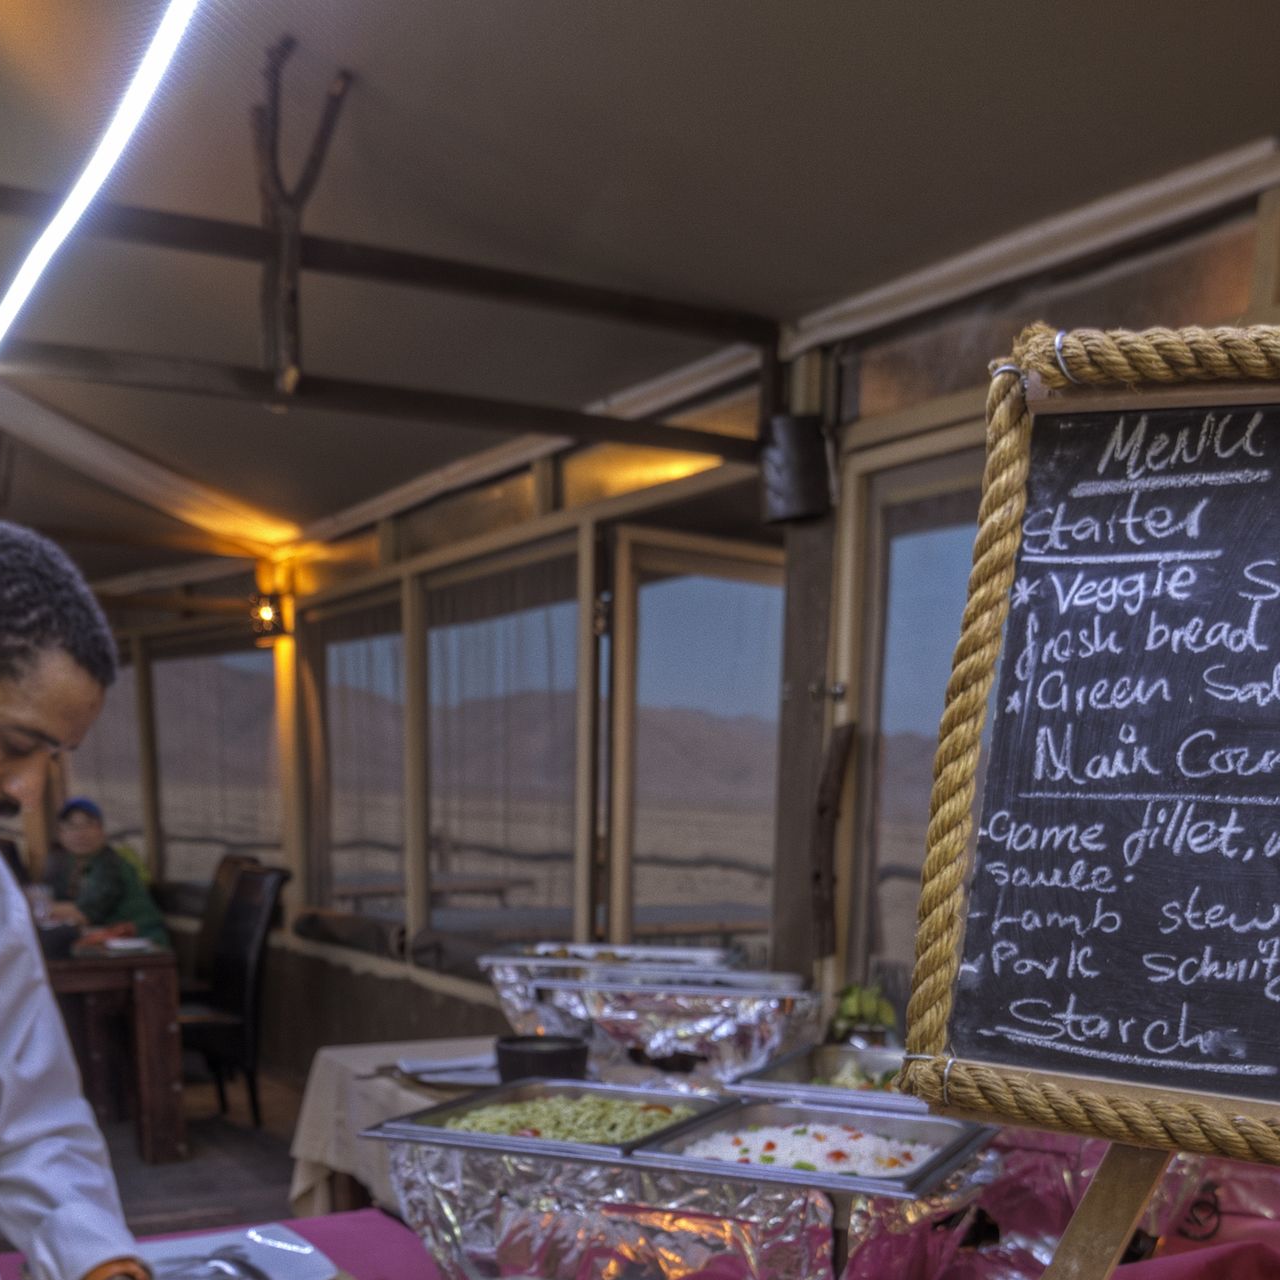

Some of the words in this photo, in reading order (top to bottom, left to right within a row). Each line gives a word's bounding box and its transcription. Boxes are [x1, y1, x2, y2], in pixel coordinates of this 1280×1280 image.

[1022, 490, 1209, 554] Starter
[1050, 560, 1197, 616] Veggie
[1145, 598, 1269, 654] bread
[1036, 670, 1171, 714] Green
[1033, 724, 1163, 784] Main
[988, 810, 1108, 853] Game
[990, 894, 1121, 938] Lamb
[991, 941, 1101, 979] Pork
